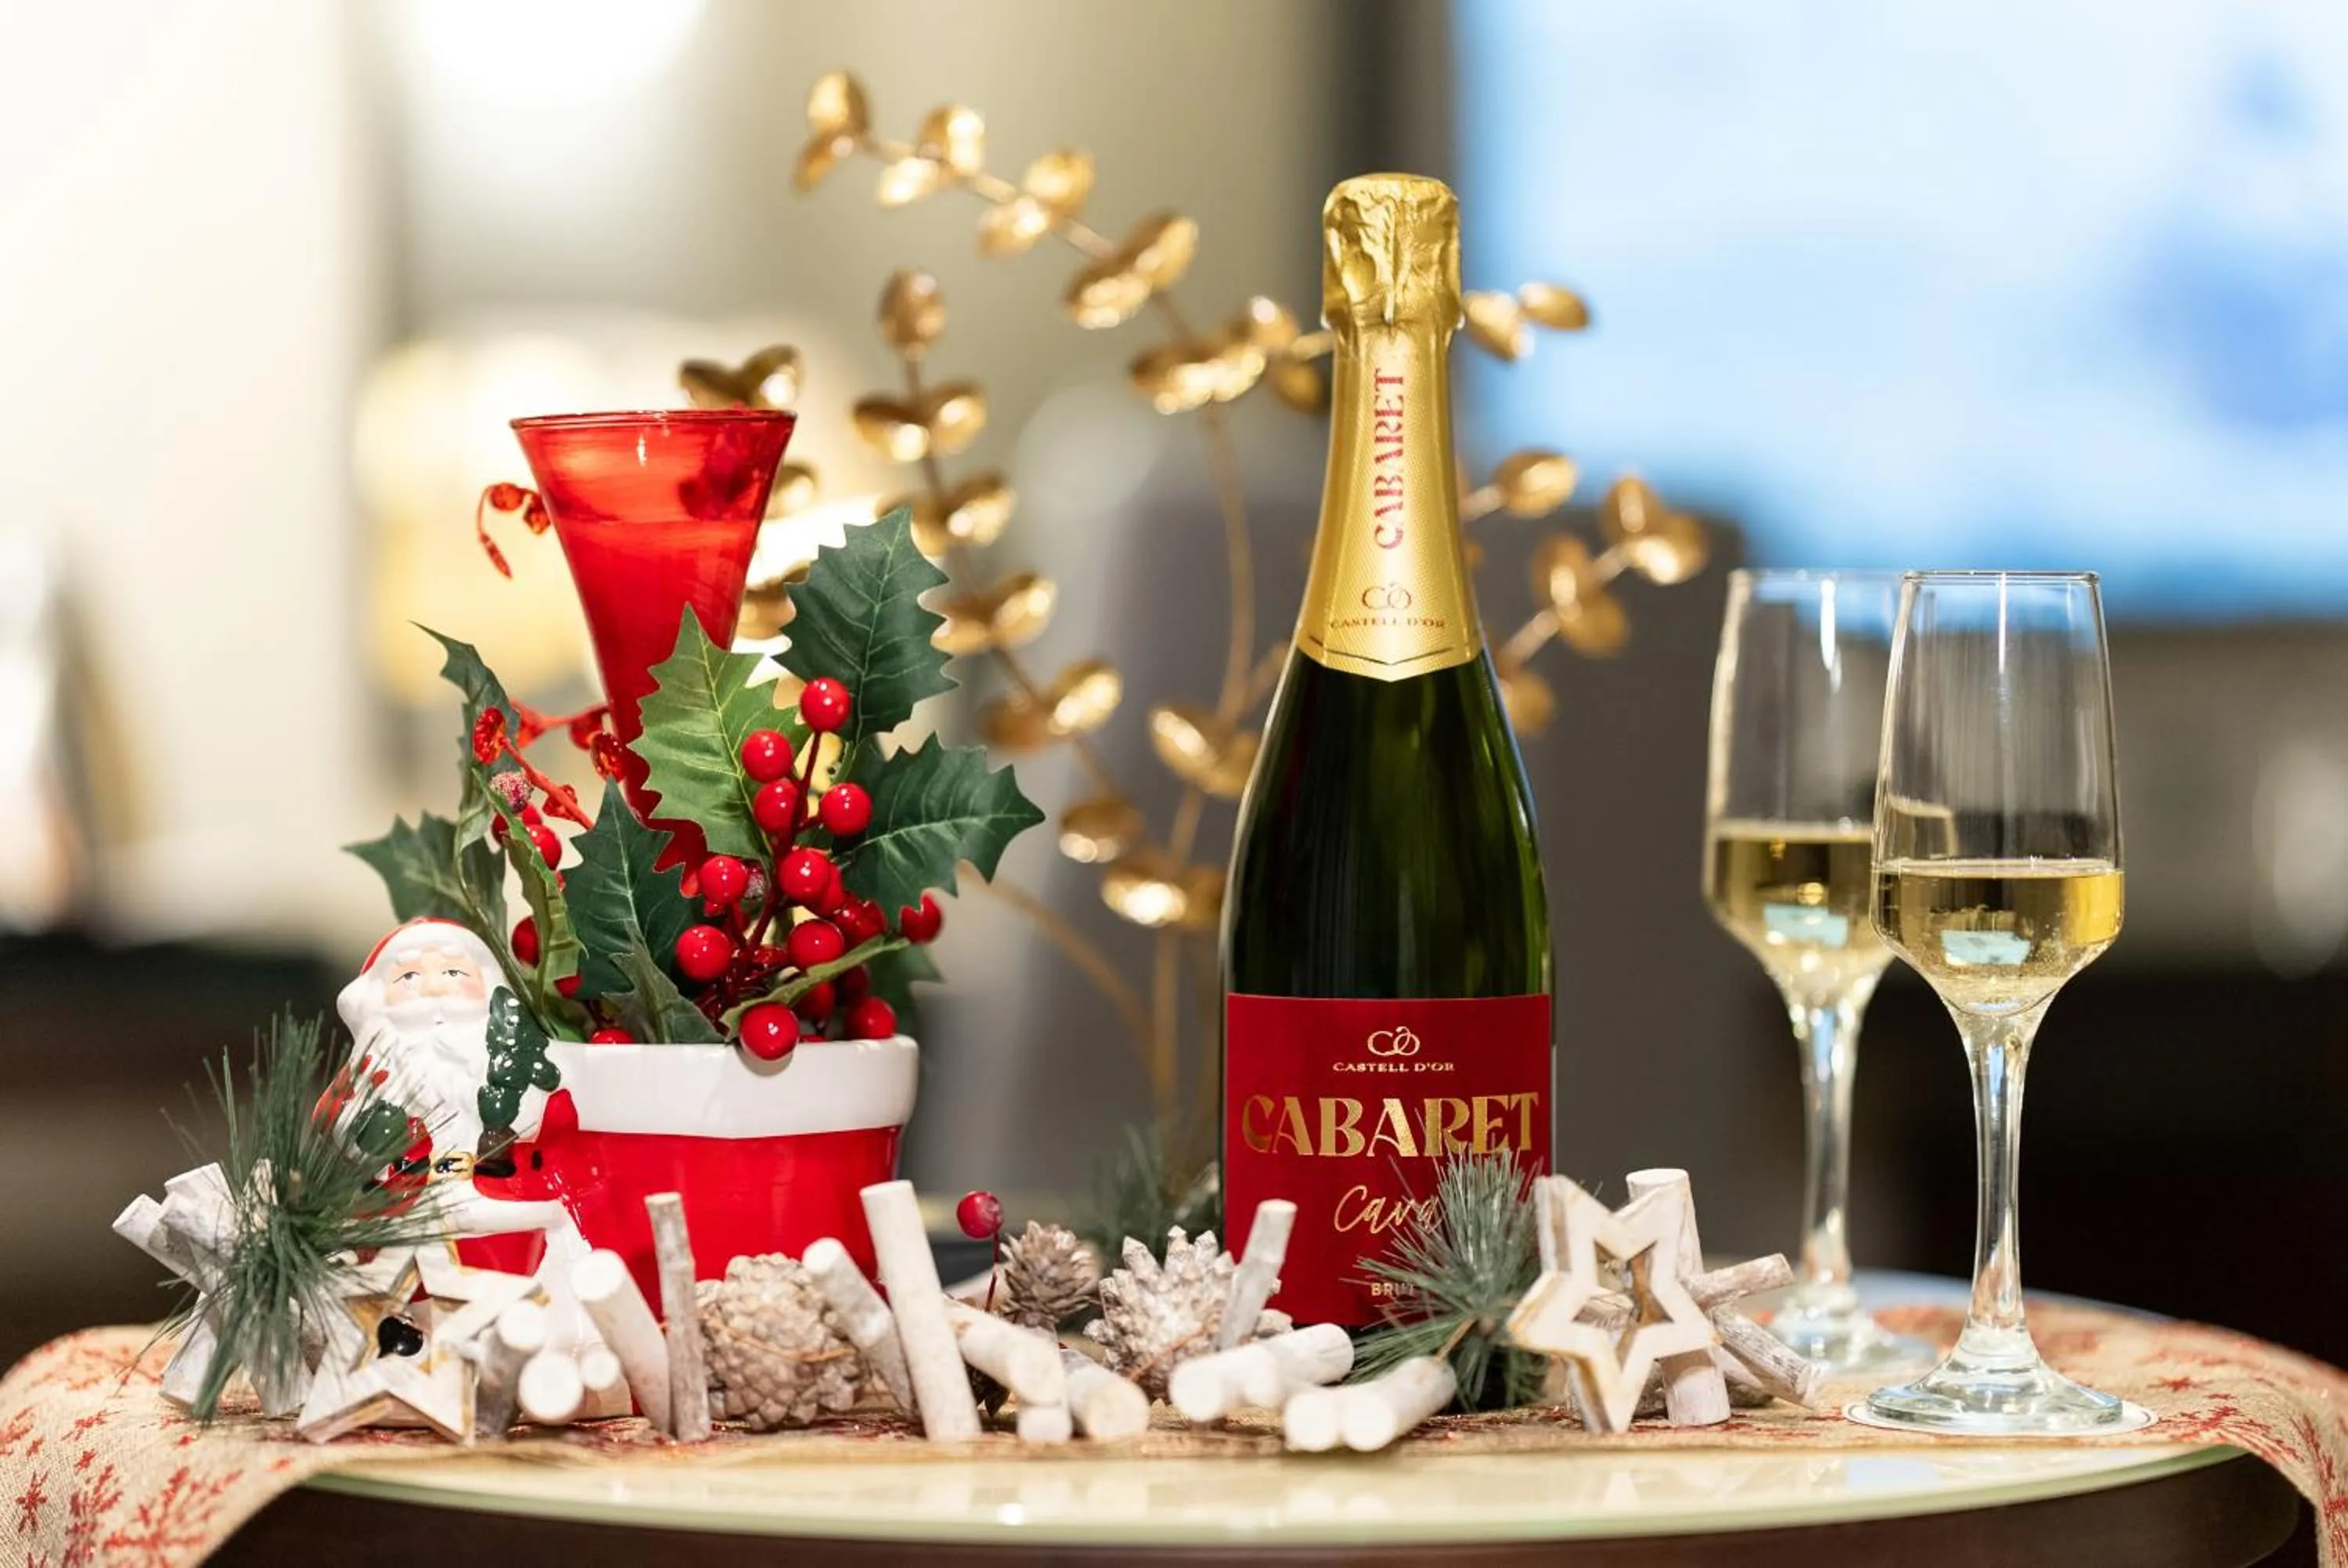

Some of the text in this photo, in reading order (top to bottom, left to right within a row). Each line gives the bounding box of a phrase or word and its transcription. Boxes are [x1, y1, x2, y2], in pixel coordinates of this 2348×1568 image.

[1374, 369, 1403, 549] CABARET
[1333, 1062, 1454, 1072] CASTELL D'OR
[1242, 1093, 1539, 1156] CABARET
[1334, 1185, 1442, 1234] Cava
